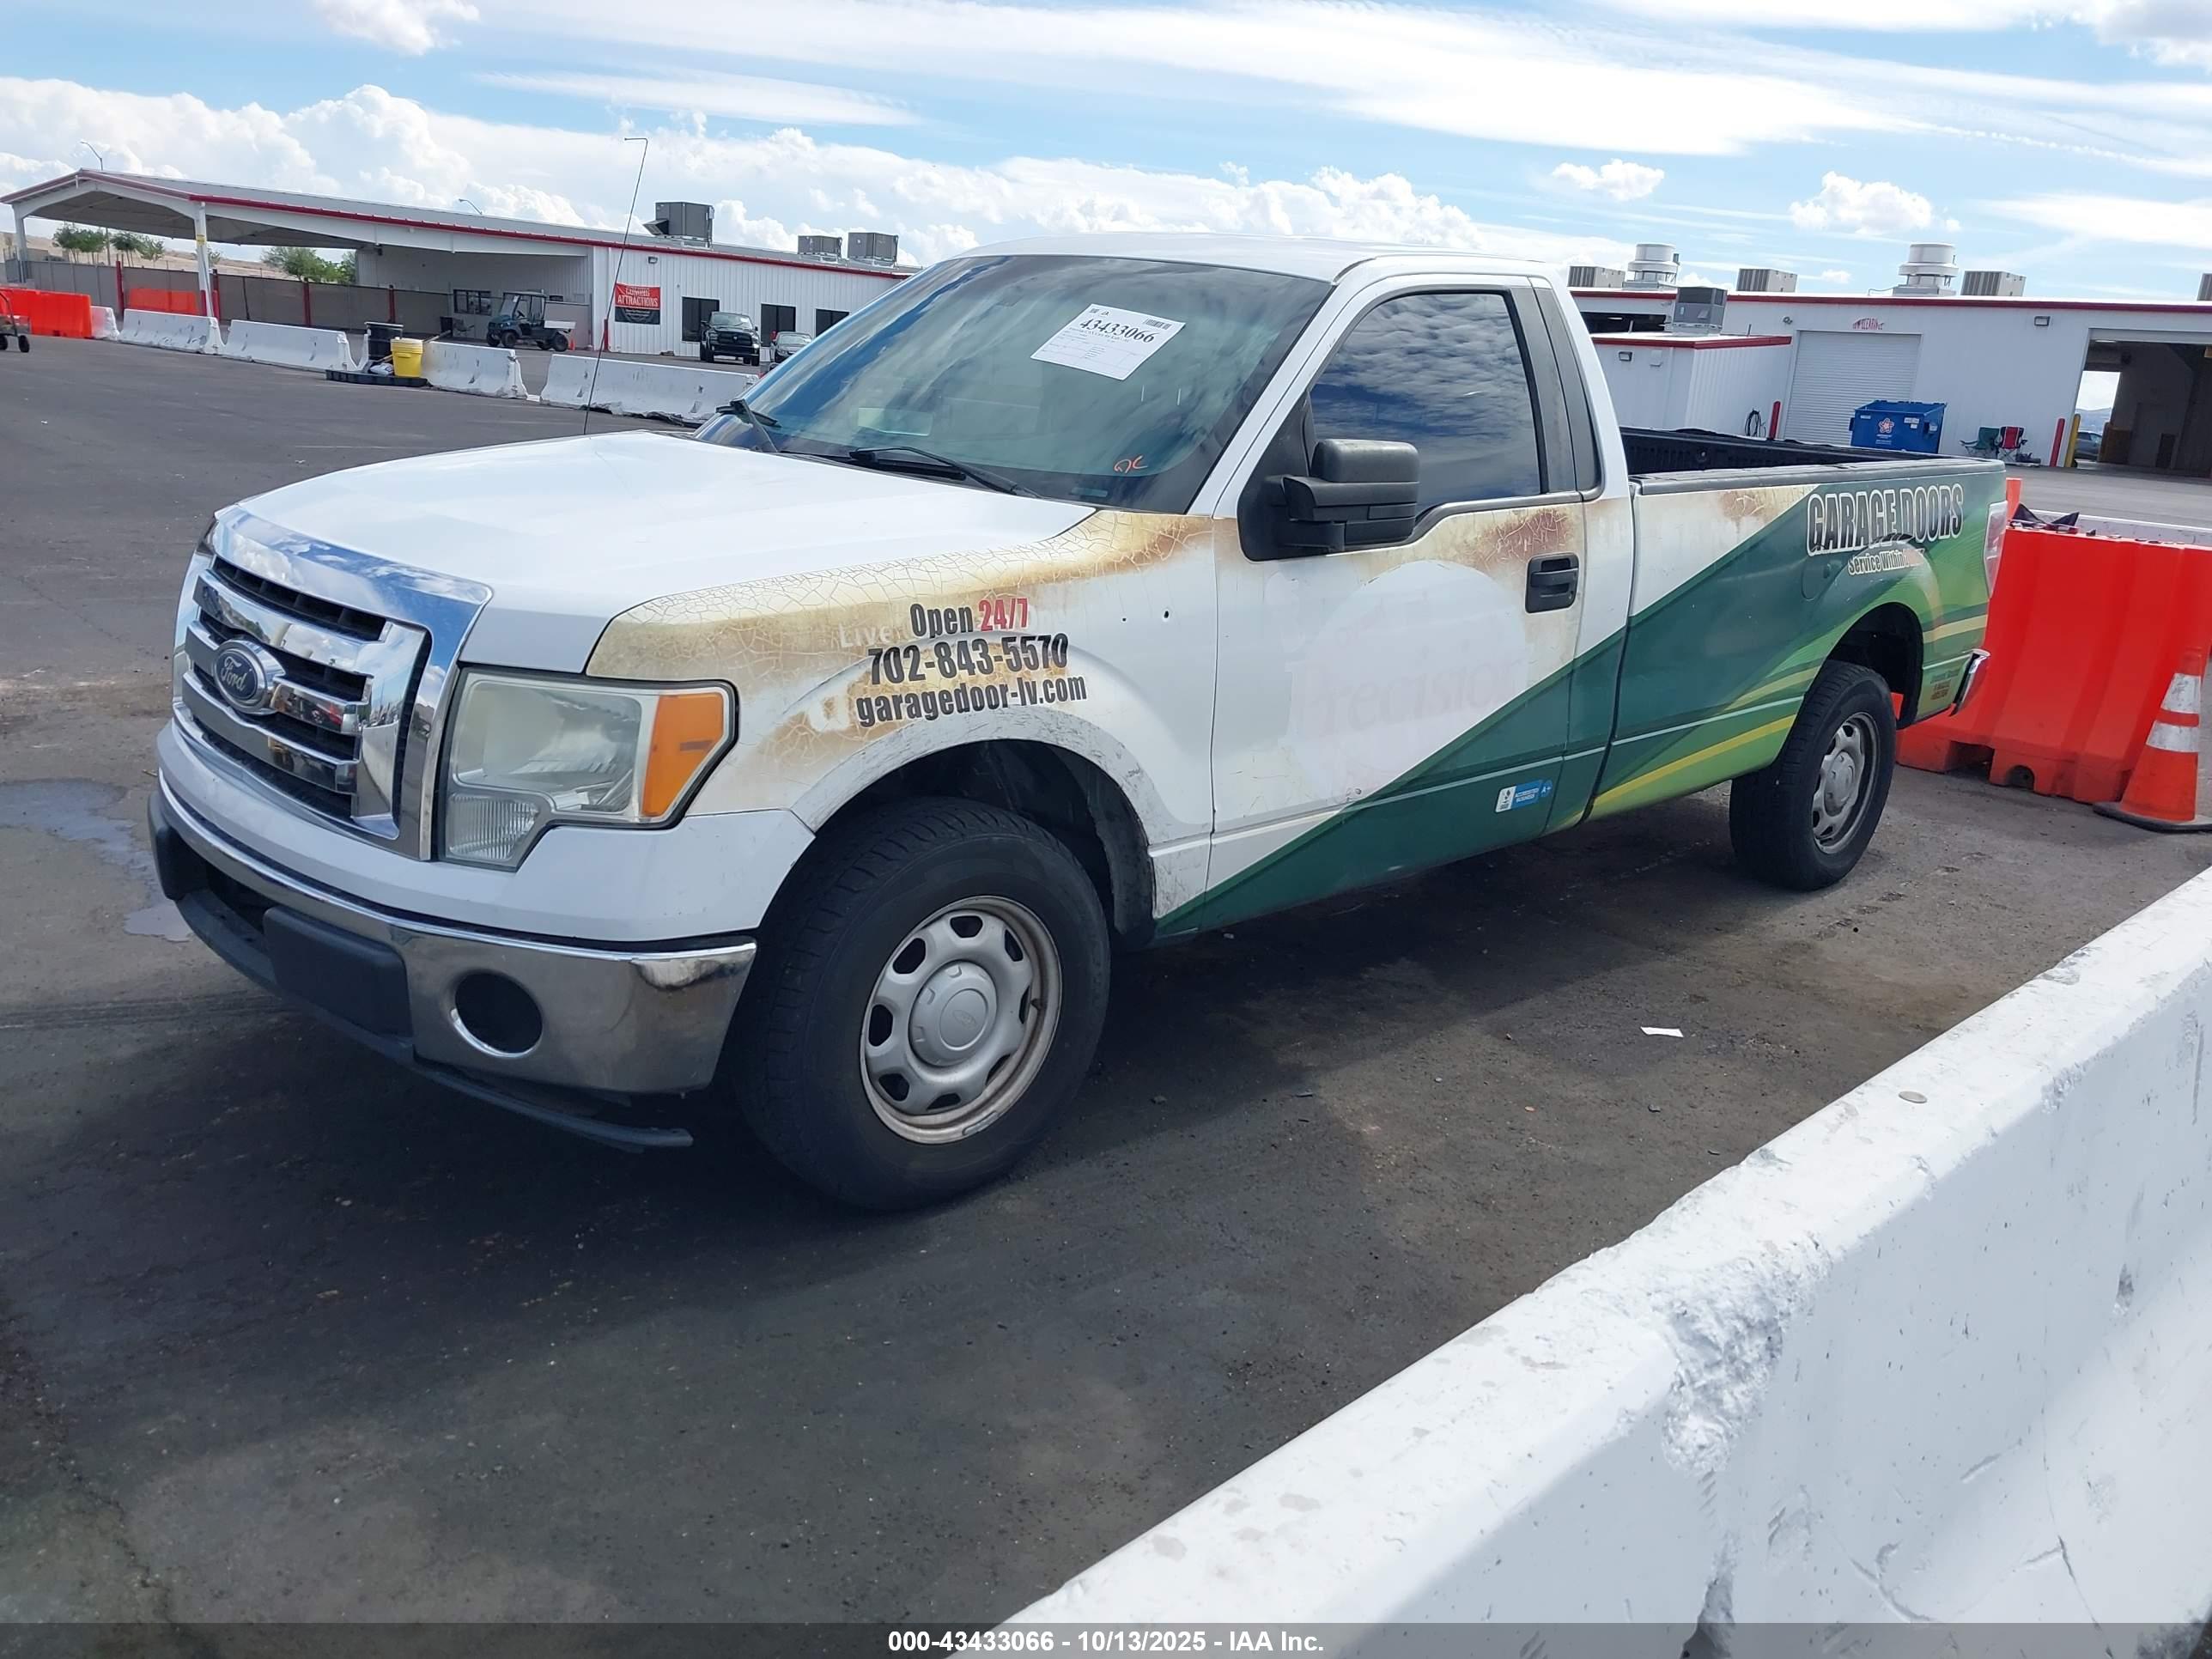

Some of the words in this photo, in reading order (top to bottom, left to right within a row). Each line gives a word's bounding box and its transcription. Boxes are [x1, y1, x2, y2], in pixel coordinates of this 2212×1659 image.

[617, 295, 659, 307] ATTRACTIONS
[1079, 319, 1159, 343] 43433066
[1807, 489, 1897, 556] GARAGE
[1899, 483, 1964, 544] DOORS
[1848, 554, 1881, 575] Service
[1880, 550, 1905, 570] Within
[909, 603, 974, 639] Open
[978, 598, 1029, 632] 24/7
[220, 656, 249, 691] Ford
[867, 633, 1069, 685] 702-843-5570
[856, 676, 1087, 727] garagedoor-lv.com
